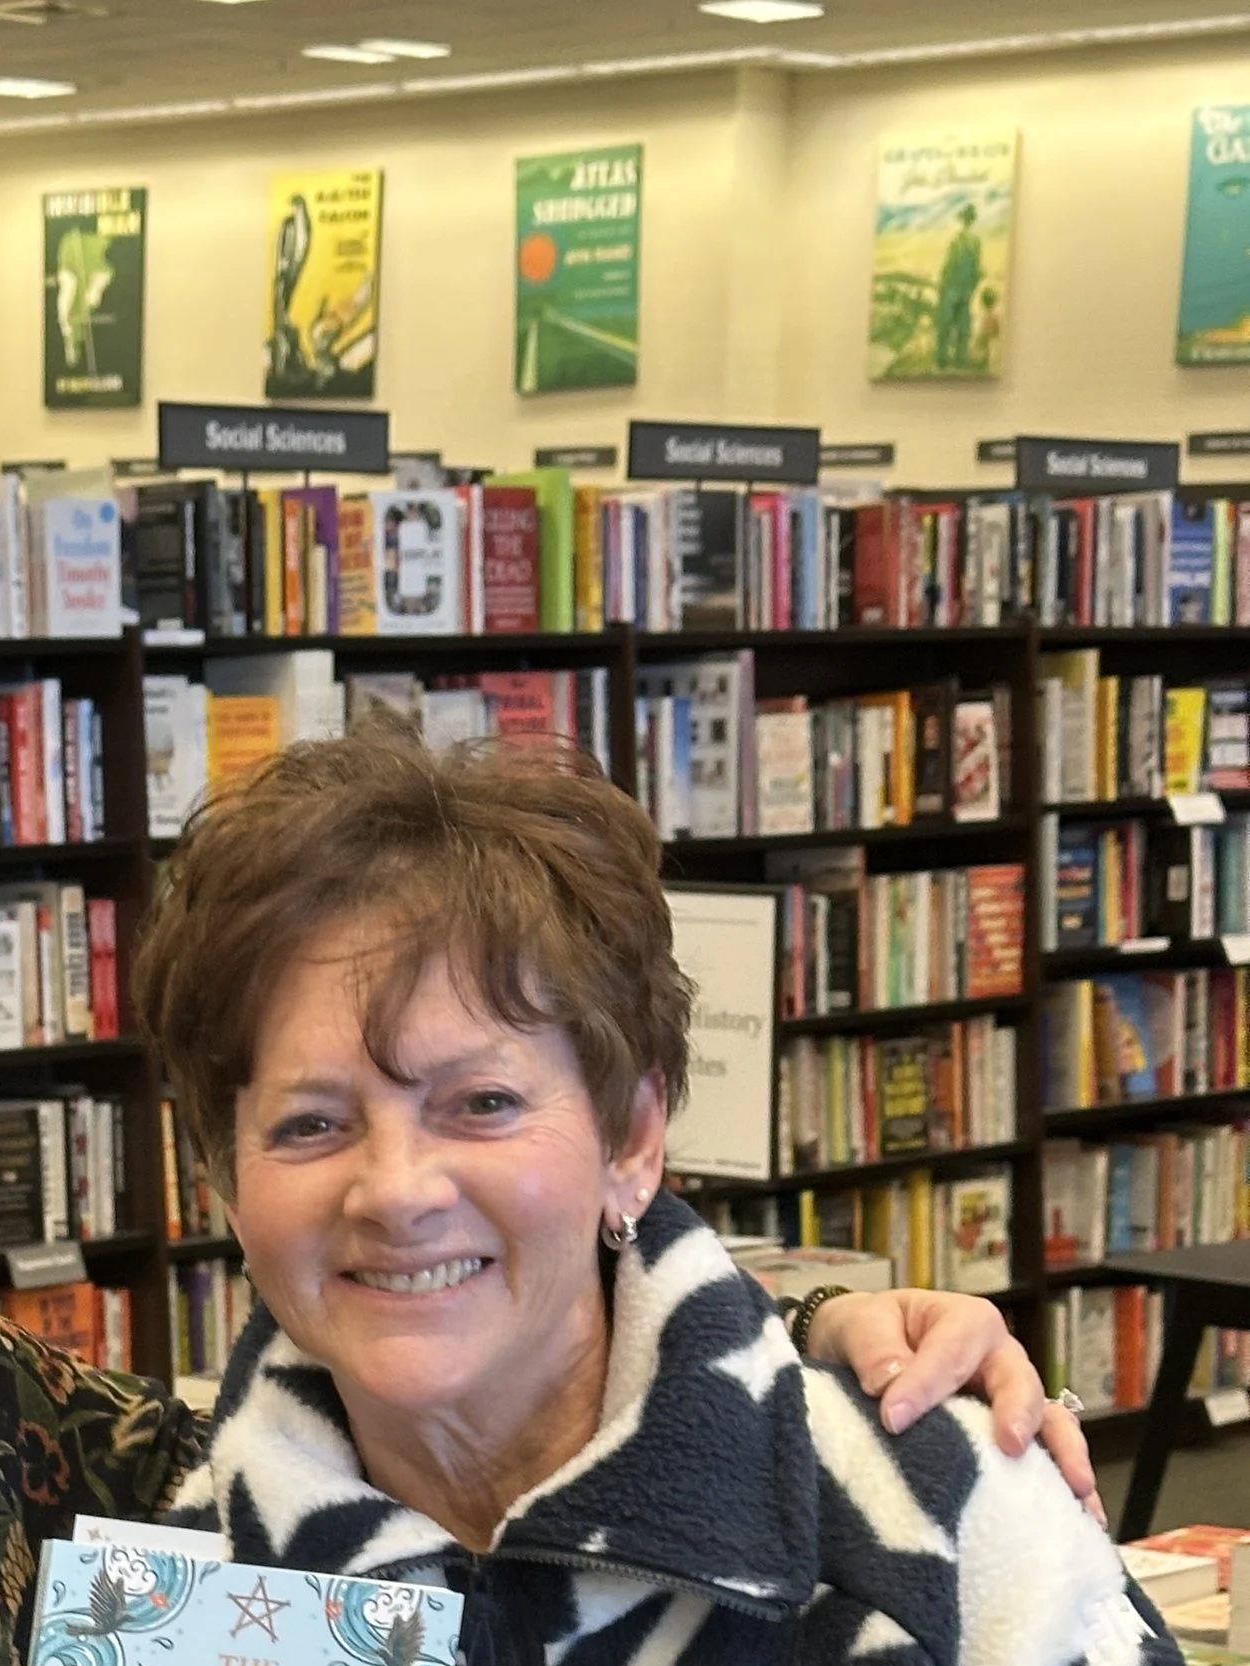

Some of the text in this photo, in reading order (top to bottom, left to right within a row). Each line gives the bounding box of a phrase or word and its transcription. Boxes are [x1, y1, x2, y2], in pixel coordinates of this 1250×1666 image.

[206, 420, 346, 456] Social Sciences
[664, 436, 783, 467] Social Sciences
[1046, 452, 1147, 478] Social Sciences
